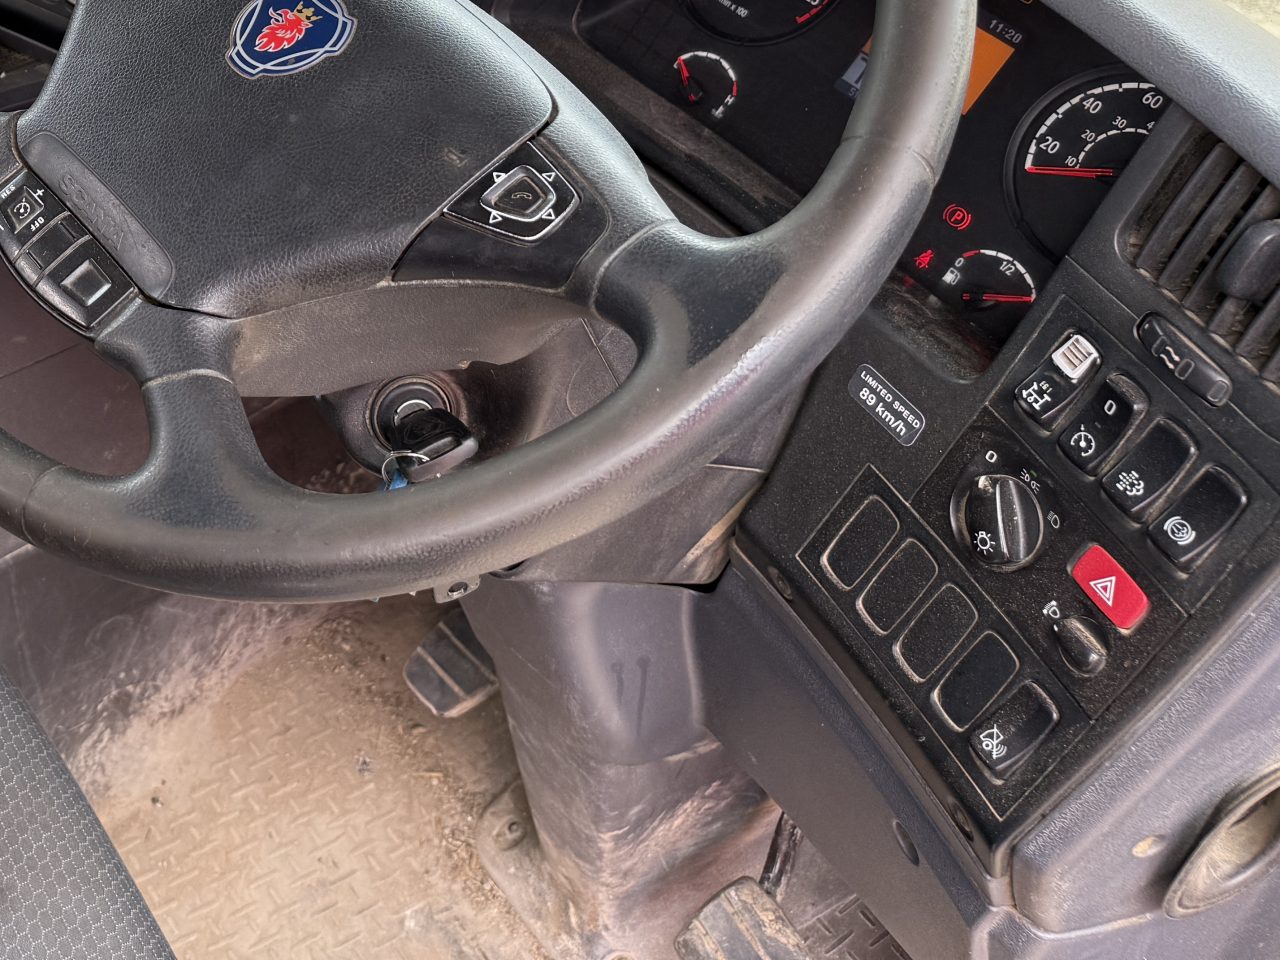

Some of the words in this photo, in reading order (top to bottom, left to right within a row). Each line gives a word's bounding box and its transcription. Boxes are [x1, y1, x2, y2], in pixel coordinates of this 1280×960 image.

[735, 5, 749, 18] 100
[989, 18, 1023, 44] 11:20
[1082, 97, 1102, 114] 40
[1141, 91, 1163, 109] 60
[1112, 115, 1127, 128] 30
[1081, 129, 1096, 141] 20
[1039, 136, 1060, 154] 20
[1064, 155, 1078, 167] 10
[1, 184, 16, 199] RES
[30, 216, 45, 232] OFF
[999, 261, 1016, 276] 1/2
[860, 370, 893, 403] LIMITED
[892, 400, 920, 428] SPEED
[859, 387, 877, 406] 89
[875, 402, 907, 437] km/h
